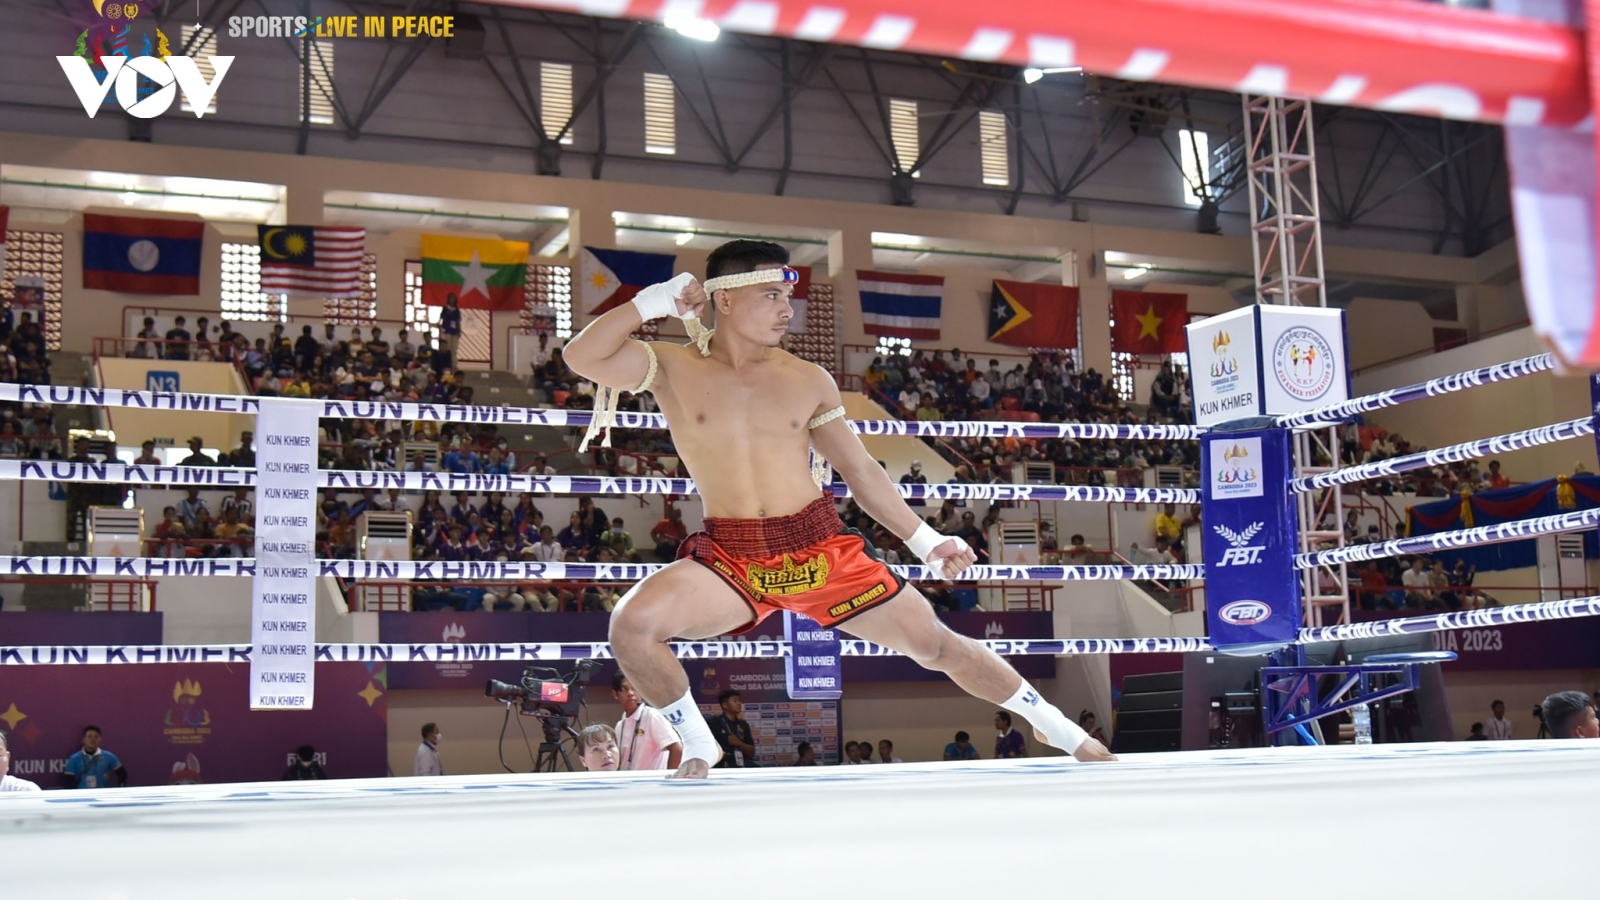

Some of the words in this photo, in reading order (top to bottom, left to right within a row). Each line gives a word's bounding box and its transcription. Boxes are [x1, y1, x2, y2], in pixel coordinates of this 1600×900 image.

[150, 376, 177, 392] N3
[19, 384, 106, 405] KUN
[1200, 400, 1219, 416] KUN
[1221, 392, 1253, 411] KHMER
[324, 402, 403, 419] KUN
[418, 403, 549, 424] KHMER
[917, 421, 1026, 437] KHMER
[1057, 424, 1118, 439] KUN
[266, 434, 282, 445] KUN
[284, 435, 310, 446] KHMER
[21, 461, 107, 480] KUN
[265, 462, 281, 473] KUN
[283, 462, 310, 474] KHMER
[327, 472, 406, 488] KUN
[421, 473, 552, 493] KHMER
[600, 478, 673, 494] KUN
[265, 488, 281, 499] KUN
[282, 489, 309, 500] KHMER
[923, 484, 1033, 500] KHMER
[1064, 486, 1126, 502] KUN
[264, 515, 279, 526] KUN
[281, 516, 308, 527] KHMER
[262, 542, 279, 552] KUN
[280, 543, 307, 553] KHMER
[11, 557, 97, 575] KUN
[115, 557, 256, 576] KHMER
[263, 567, 280, 578] KUN
[281, 567, 308, 578] KHMER
[320, 561, 399, 578] KUN
[414, 561, 548, 579] KHMER
[714, 560, 733, 576] KUN
[1062, 565, 1124, 580] KUN
[785, 583, 810, 594] KHMER
[263, 593, 279, 604] KUN
[280, 594, 307, 605] KHMER
[830, 603, 851, 616] KUN
[852, 583, 886, 607] KHMER
[262, 621, 278, 632] KUN
[280, 621, 307, 632] KHMER
[797, 631, 811, 641] KUN
[811, 631, 835, 641] KHMER
[1462, 629, 1503, 651] 2023
[261, 645, 278, 655] KUN
[279, 645, 307, 656] KHMER
[314, 645, 393, 661] KUN
[409, 645, 541, 661] KHMER
[1062, 639, 1124, 654] KUN
[0, 647, 88, 665] KUN
[106, 646, 253, 664] KHMER
[798, 656, 812, 667] KUN
[812, 656, 836, 666] KHMER
[260, 672, 277, 683] KUN
[278, 672, 306, 683] KHMER
[729, 674, 771, 682] CAMBODIA
[799, 678, 813, 688] KUN
[813, 677, 836, 687] KHMER
[260, 696, 276, 706] KUN
[277, 696, 305, 706] KHMER
[14, 760, 45, 774] KUN
